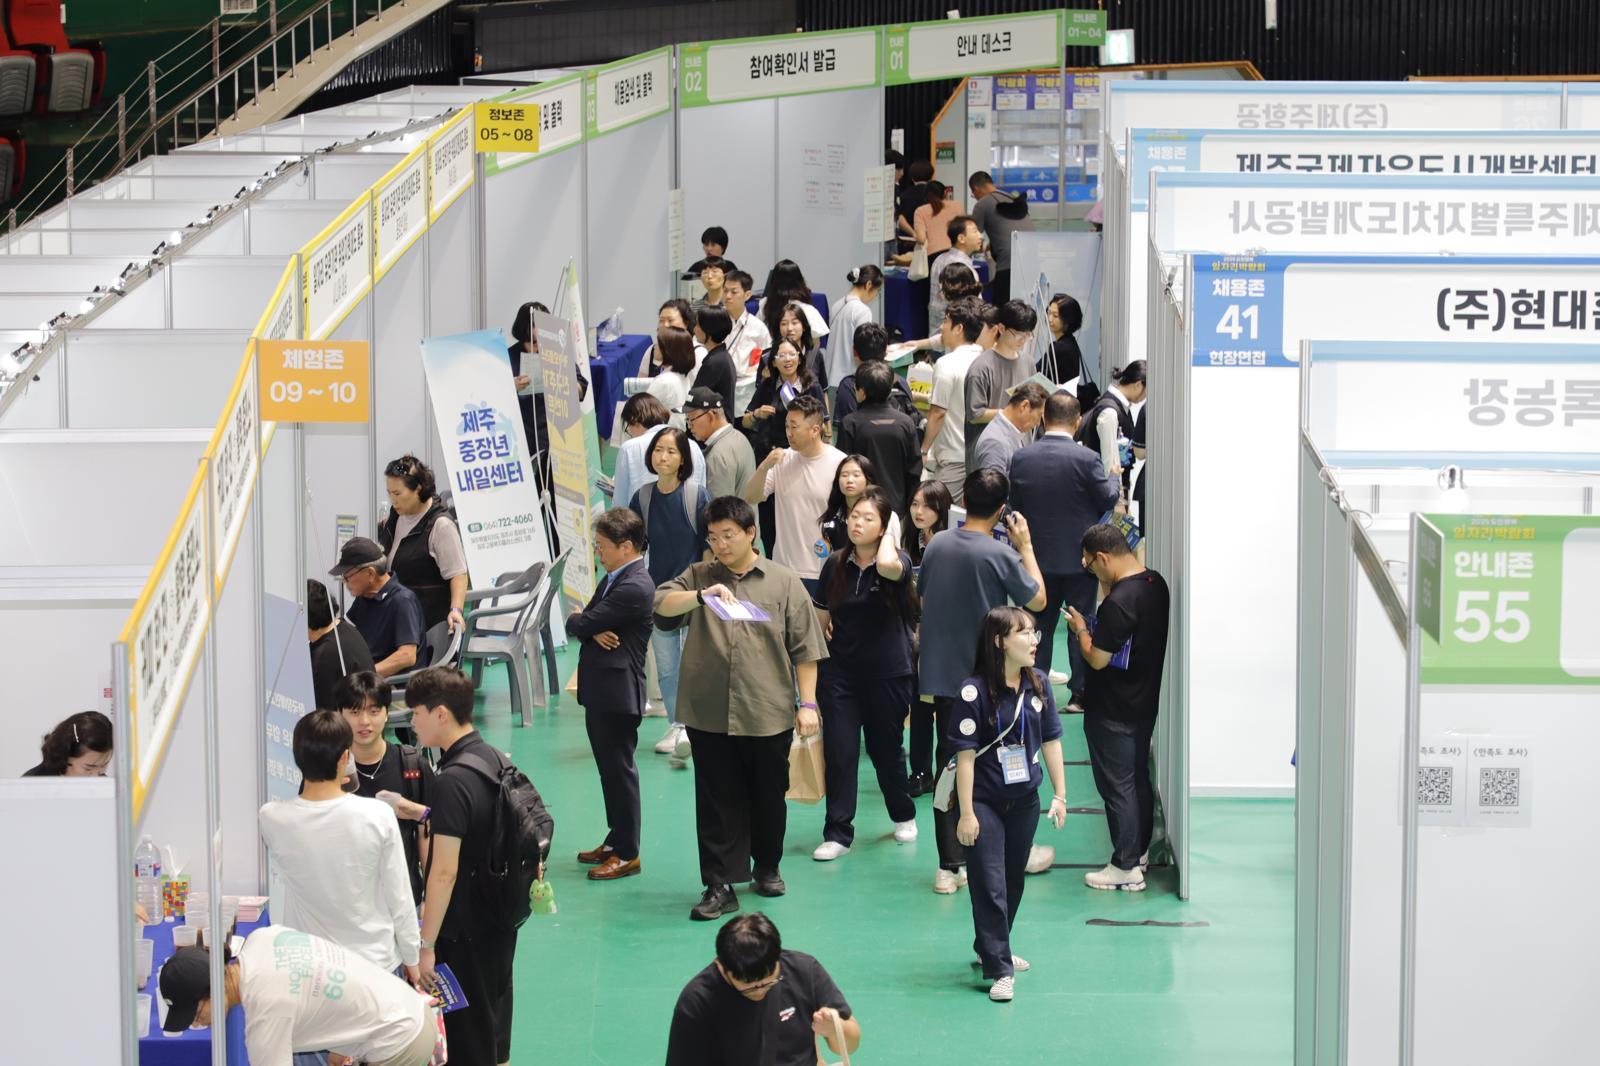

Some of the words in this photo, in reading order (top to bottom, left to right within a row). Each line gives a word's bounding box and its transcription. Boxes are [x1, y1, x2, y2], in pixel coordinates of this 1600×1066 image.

[957, 35, 977, 57] 안내
[981, 31, 1011, 54] 데스크
[750, 51, 809, 80] 참여확인서
[813, 48, 836, 72] 발급
[890, 52, 903, 70] 01
[685, 72, 702, 92] 02
[489, 108, 525, 121] 정보존
[1147, 146, 1187, 160] 채용존
[1212, 278, 1265, 297] 채용존
[1216, 304, 1259, 340] 41
[1436, 287, 1600, 332] (주)현대
[282, 348, 344, 370] 체험존
[1209, 350, 1266, 366] 현장면접
[460, 407, 496, 433] 제주
[458, 434, 510, 463] 중장년
[456, 461, 524, 492] 내일센터
[1454, 551, 1533, 578] 안내존
[1454, 590, 1531, 643] 55
[273, 947, 288, 971] THE
[288, 947, 302, 994] NORTH
[301, 948, 313, 979] FACE
[323, 967, 347, 1001] 66
